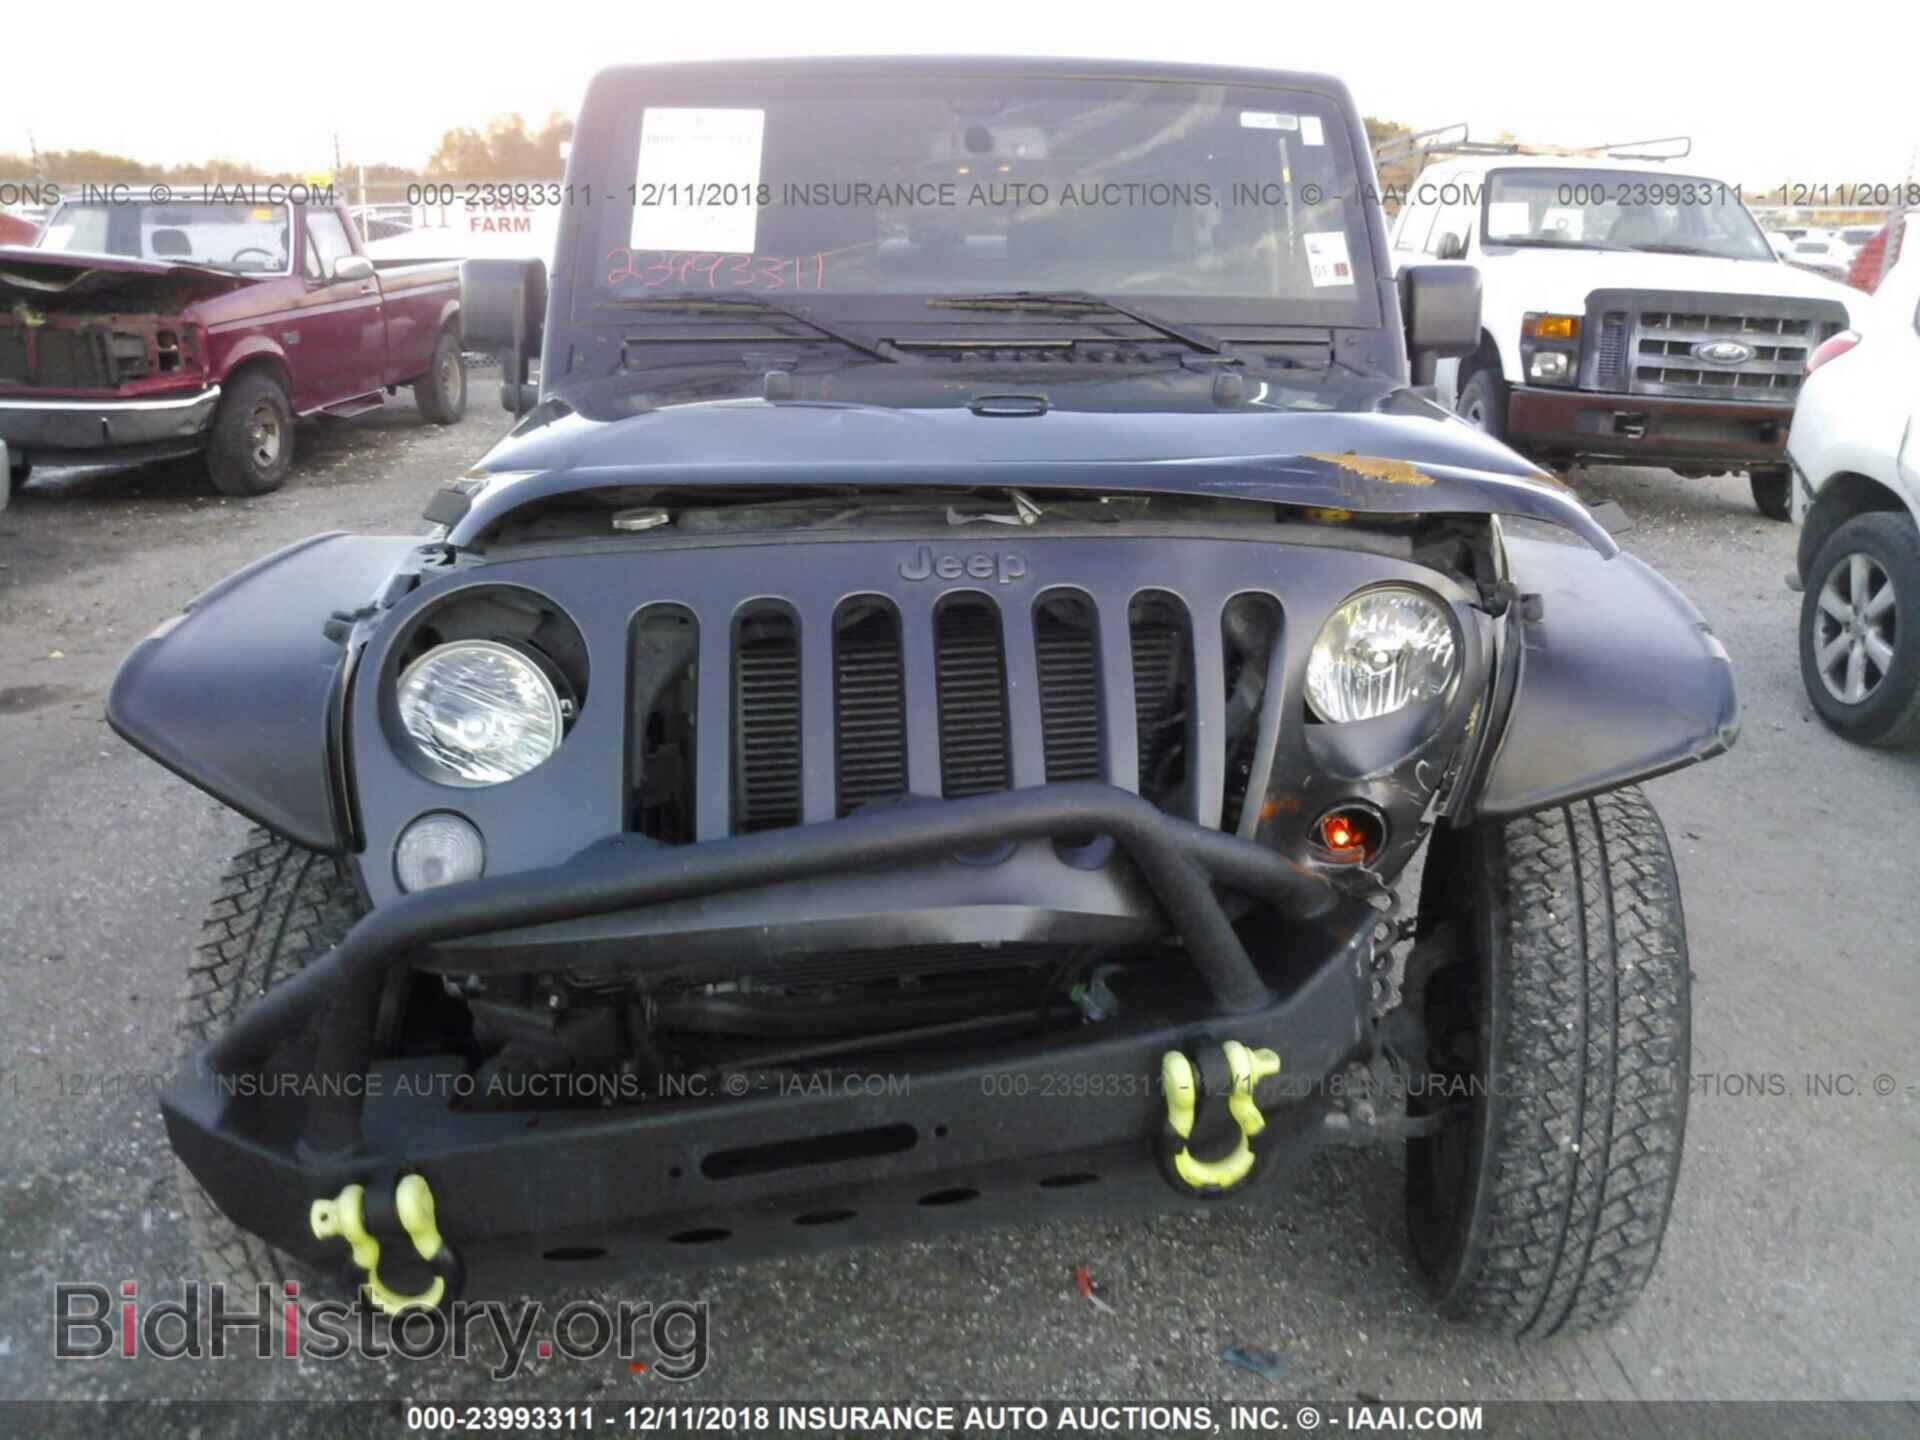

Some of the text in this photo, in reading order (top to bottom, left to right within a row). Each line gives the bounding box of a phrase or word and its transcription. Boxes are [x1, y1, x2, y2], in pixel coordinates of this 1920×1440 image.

[464, 195, 536, 212] STATE
[469, 216, 532, 233] FARM
[899, 545, 1026, 584] Jeep
